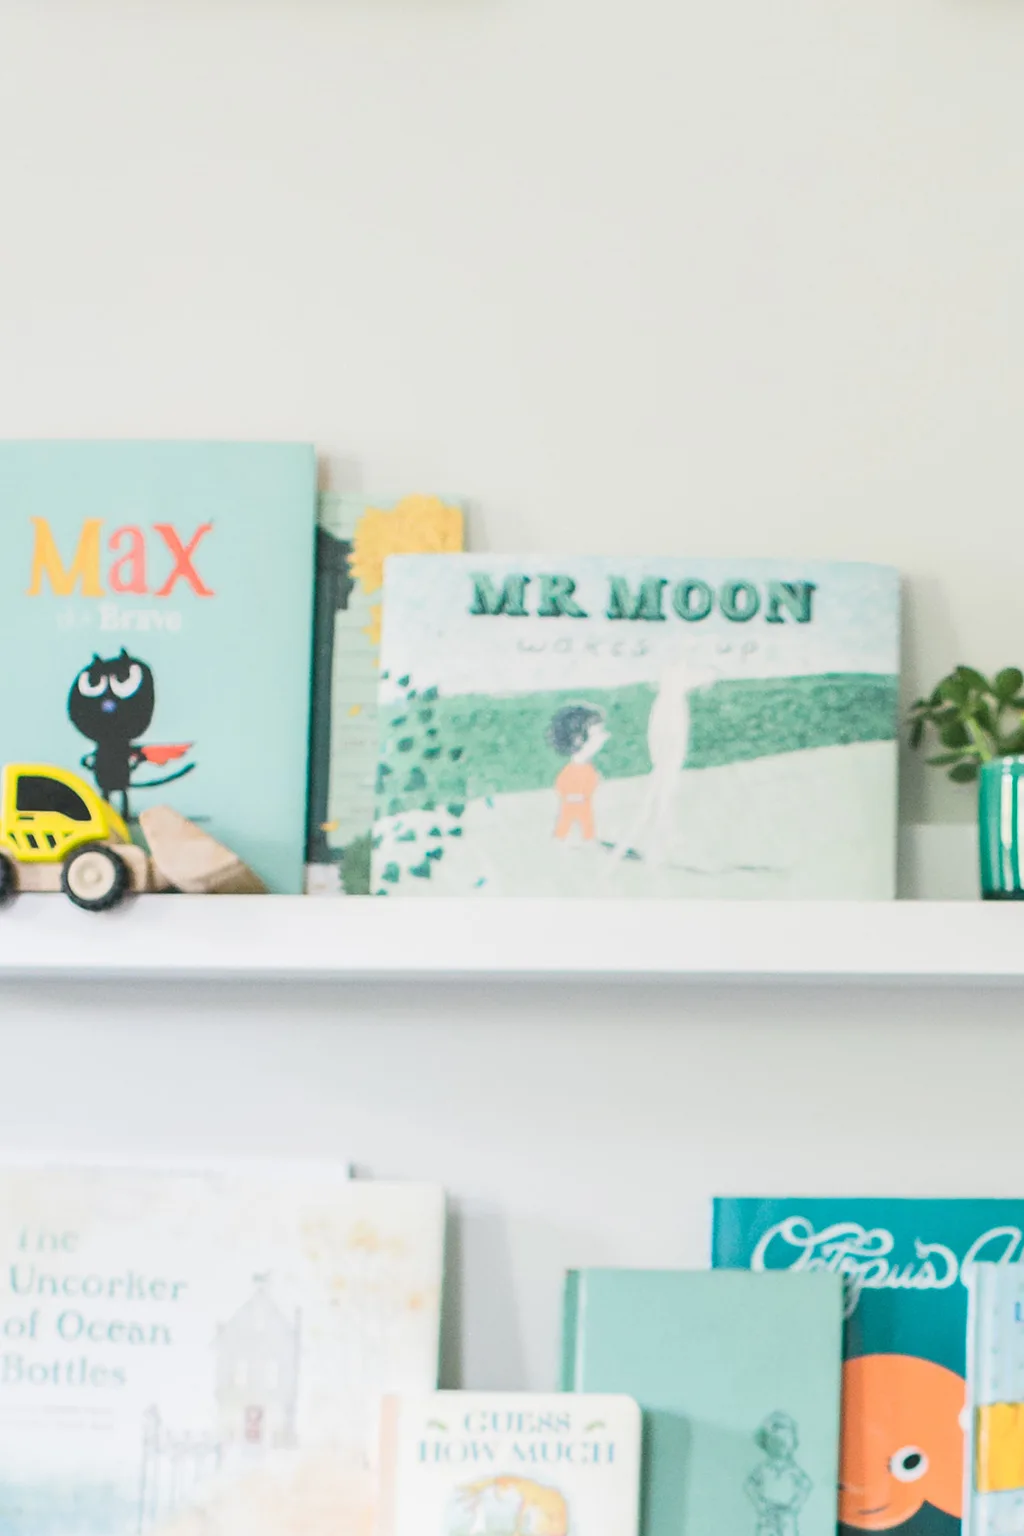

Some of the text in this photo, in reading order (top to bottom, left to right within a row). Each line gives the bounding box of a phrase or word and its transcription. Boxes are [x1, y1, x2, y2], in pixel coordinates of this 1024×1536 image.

[25, 516, 215, 597] Max
[468, 572, 818, 625] MR MOON
[17, 1223, 80, 1254] The
[8, 1263, 189, 1301] Uncorker
[2, 1308, 172, 1345] of Ocean
[1, 1351, 127, 1388] Bottles
[463, 1411, 572, 1433] GUESS
[418, 1440, 616, 1464] HOW MUCH
